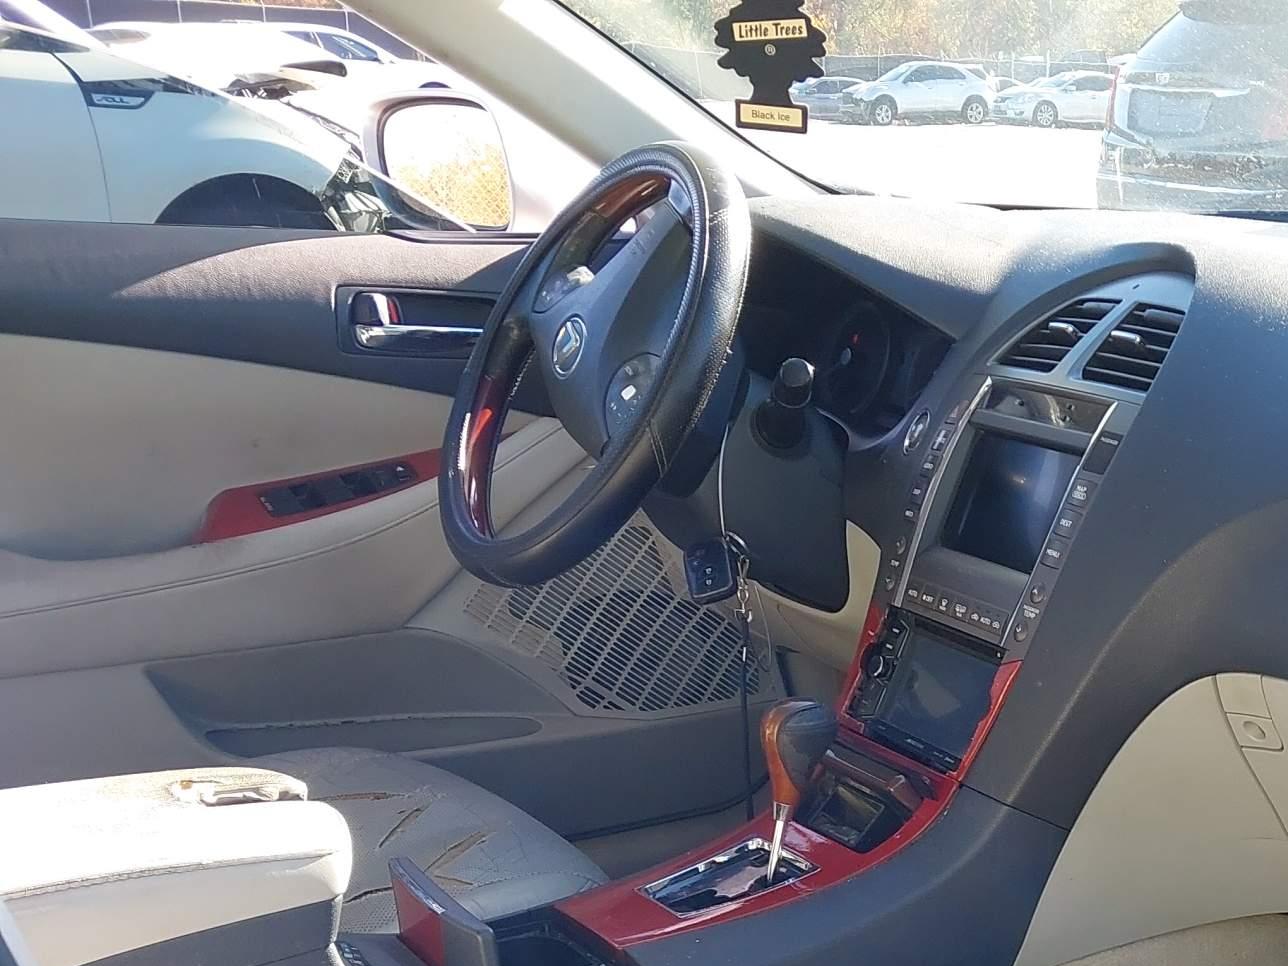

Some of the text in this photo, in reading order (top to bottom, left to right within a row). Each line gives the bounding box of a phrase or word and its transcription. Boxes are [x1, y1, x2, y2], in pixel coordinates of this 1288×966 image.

[738, 22, 803, 39] Little Trees
[751, 109, 791, 122] Black Ice
